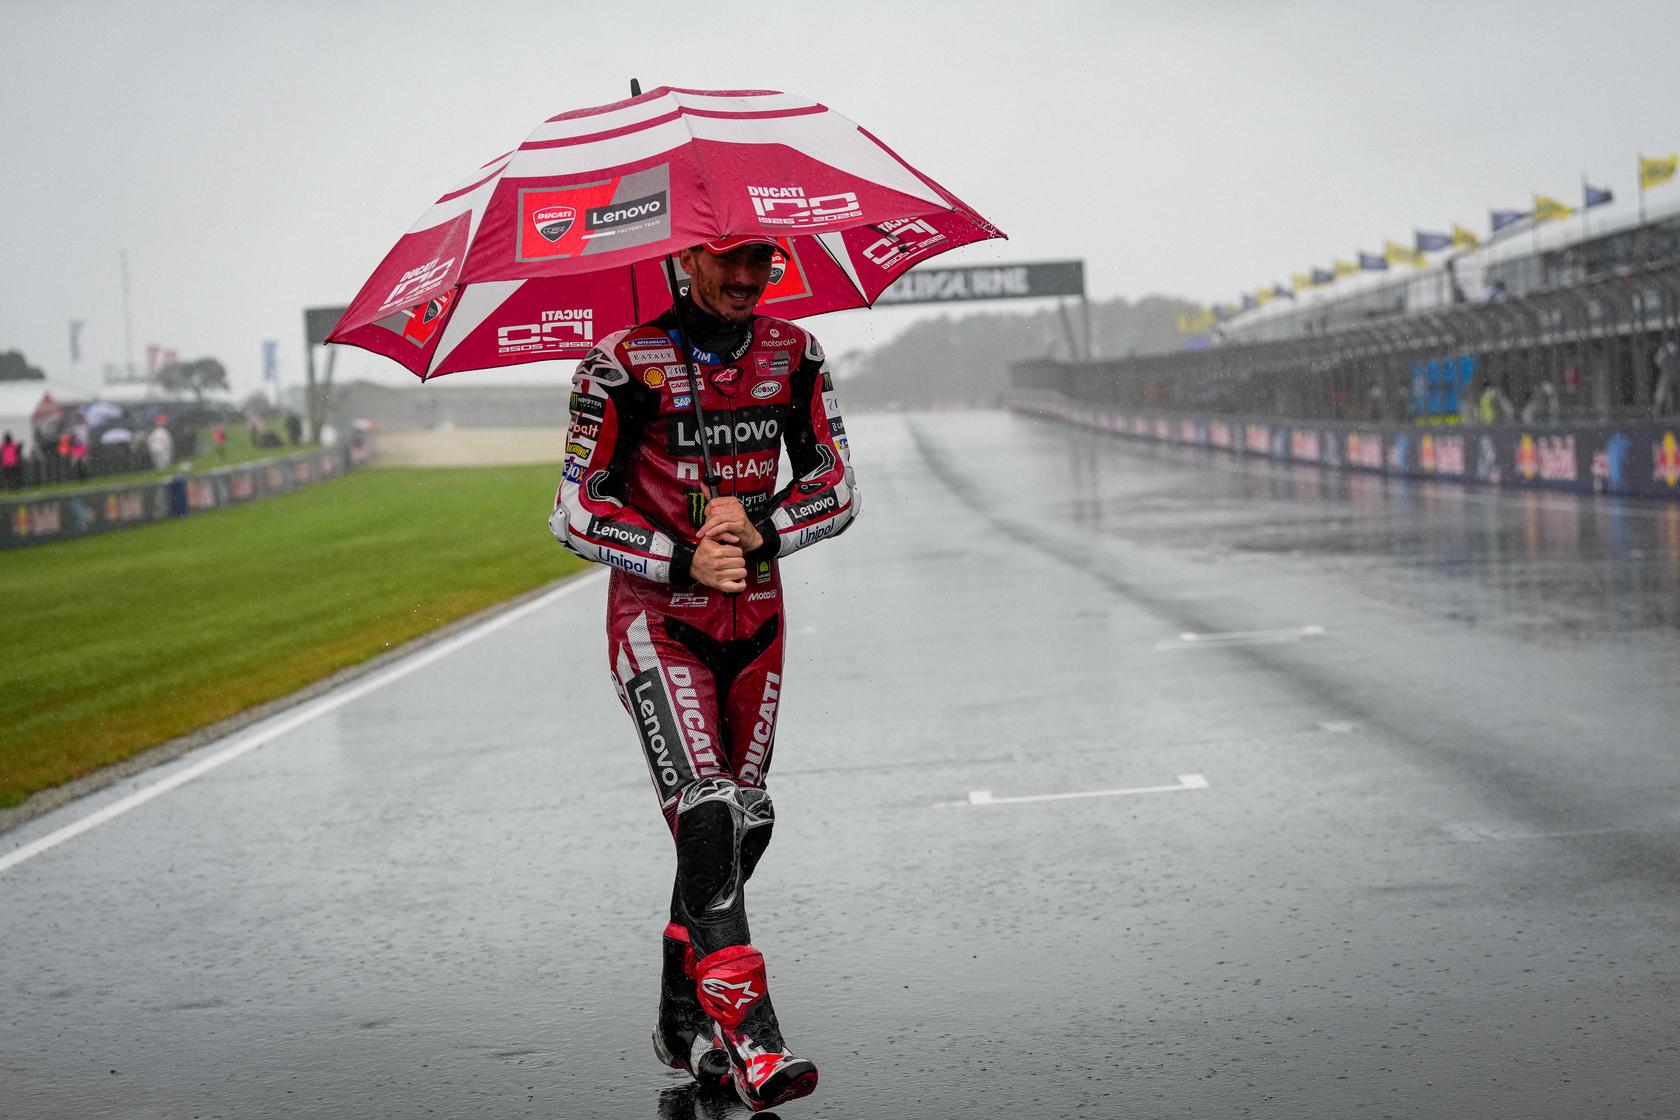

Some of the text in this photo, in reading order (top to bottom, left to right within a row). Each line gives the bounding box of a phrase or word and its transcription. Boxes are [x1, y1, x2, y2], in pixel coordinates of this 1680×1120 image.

[747, 186, 805, 197] DUCATI
[537, 211, 572, 220] DUCATI
[592, 201, 661, 225] Lenovo
[617, 219, 661, 234] FACTORY TEAM
[400, 257, 440, 283] DUCATI
[731, 331, 753, 360] Lenovo
[761, 337, 797, 347] motorola
[633, 351, 673, 360] EATALY
[692, 346, 711, 363] TIM
[754, 384, 780, 394] SUOMY
[673, 396, 692, 408] SAP
[677, 419, 778, 447] Lenovo
[789, 495, 835, 519] Lenovo
[592, 521, 647, 546] Lenovo
[800, 518, 835, 545] Unipol
[599, 546, 648, 574] Unipol
[667, 666, 721, 776] DUCATI
[738, 671, 781, 784] DUCATI
[634, 681, 679, 787] Lenovo
